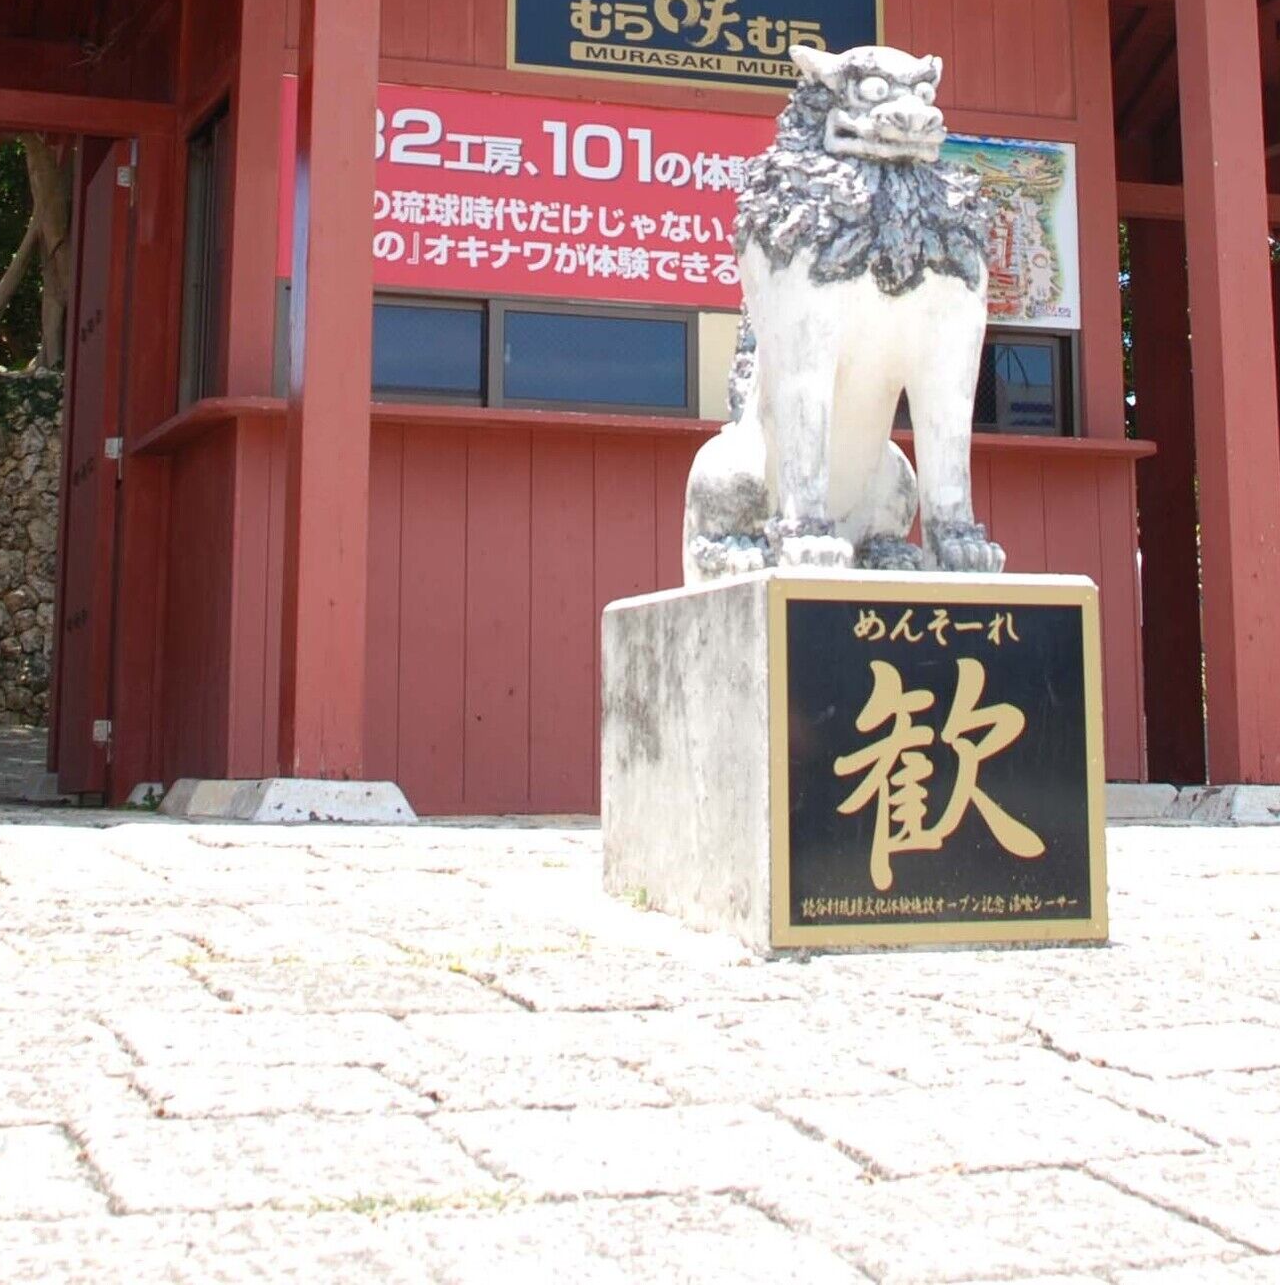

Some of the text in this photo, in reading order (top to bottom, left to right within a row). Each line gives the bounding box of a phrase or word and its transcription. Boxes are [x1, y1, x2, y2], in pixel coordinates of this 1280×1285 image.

[584, 45, 721, 72] MURASAKI
[853, 608, 1020, 647] めんそーれ
[832, 657, 1047, 893] 歓
